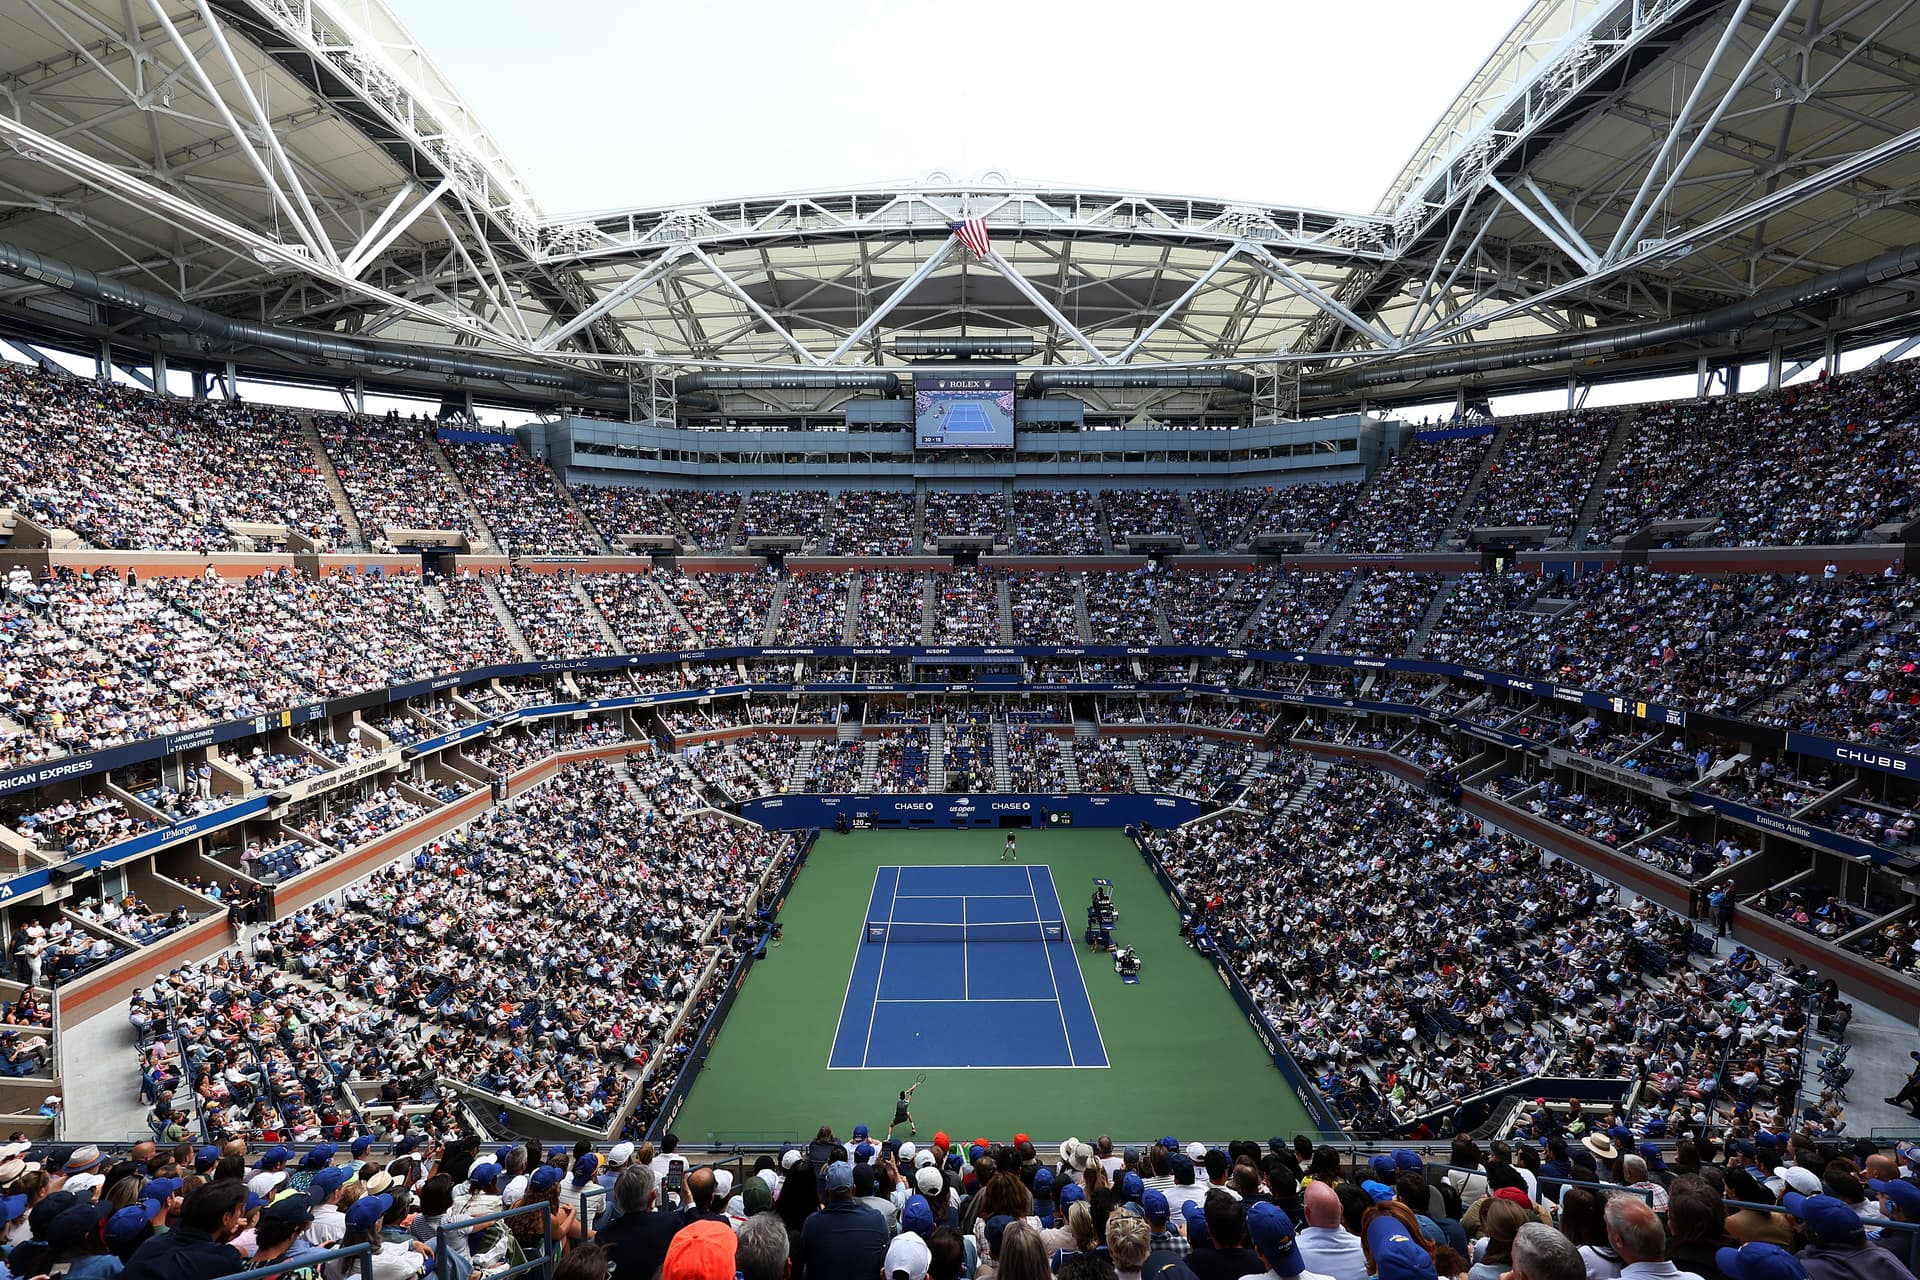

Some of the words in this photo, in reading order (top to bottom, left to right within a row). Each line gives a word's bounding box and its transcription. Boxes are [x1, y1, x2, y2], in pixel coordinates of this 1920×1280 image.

[541, 661, 588, 670] CADILLAC
[1283, 694, 1304, 702] CHASE
[310, 710, 323, 720] IBM
[1666, 715, 1681, 725] IBM
[174, 732, 194, 743] JANNIK
[195, 729, 214, 738] SINNER
[445, 732, 461, 743] CHASE
[175, 742, 197, 752] TAYLOR
[197, 738, 213, 747] FRITZ
[1836, 748, 1907, 770] CHUBB
[40, 760, 93, 780] EXPRESS
[307, 776, 337, 793] ARTHUR
[339, 769, 358, 781] ASHE
[359, 759, 387, 775] STADIUM
[1757, 815, 1785, 830] Emirates
[1786, 824, 1811, 837] Airline
[1249, 1013, 1276, 1056] CHUBB
[1297, 1084, 1309, 1107] IHG
[662, 1094, 684, 1137] FAGE
